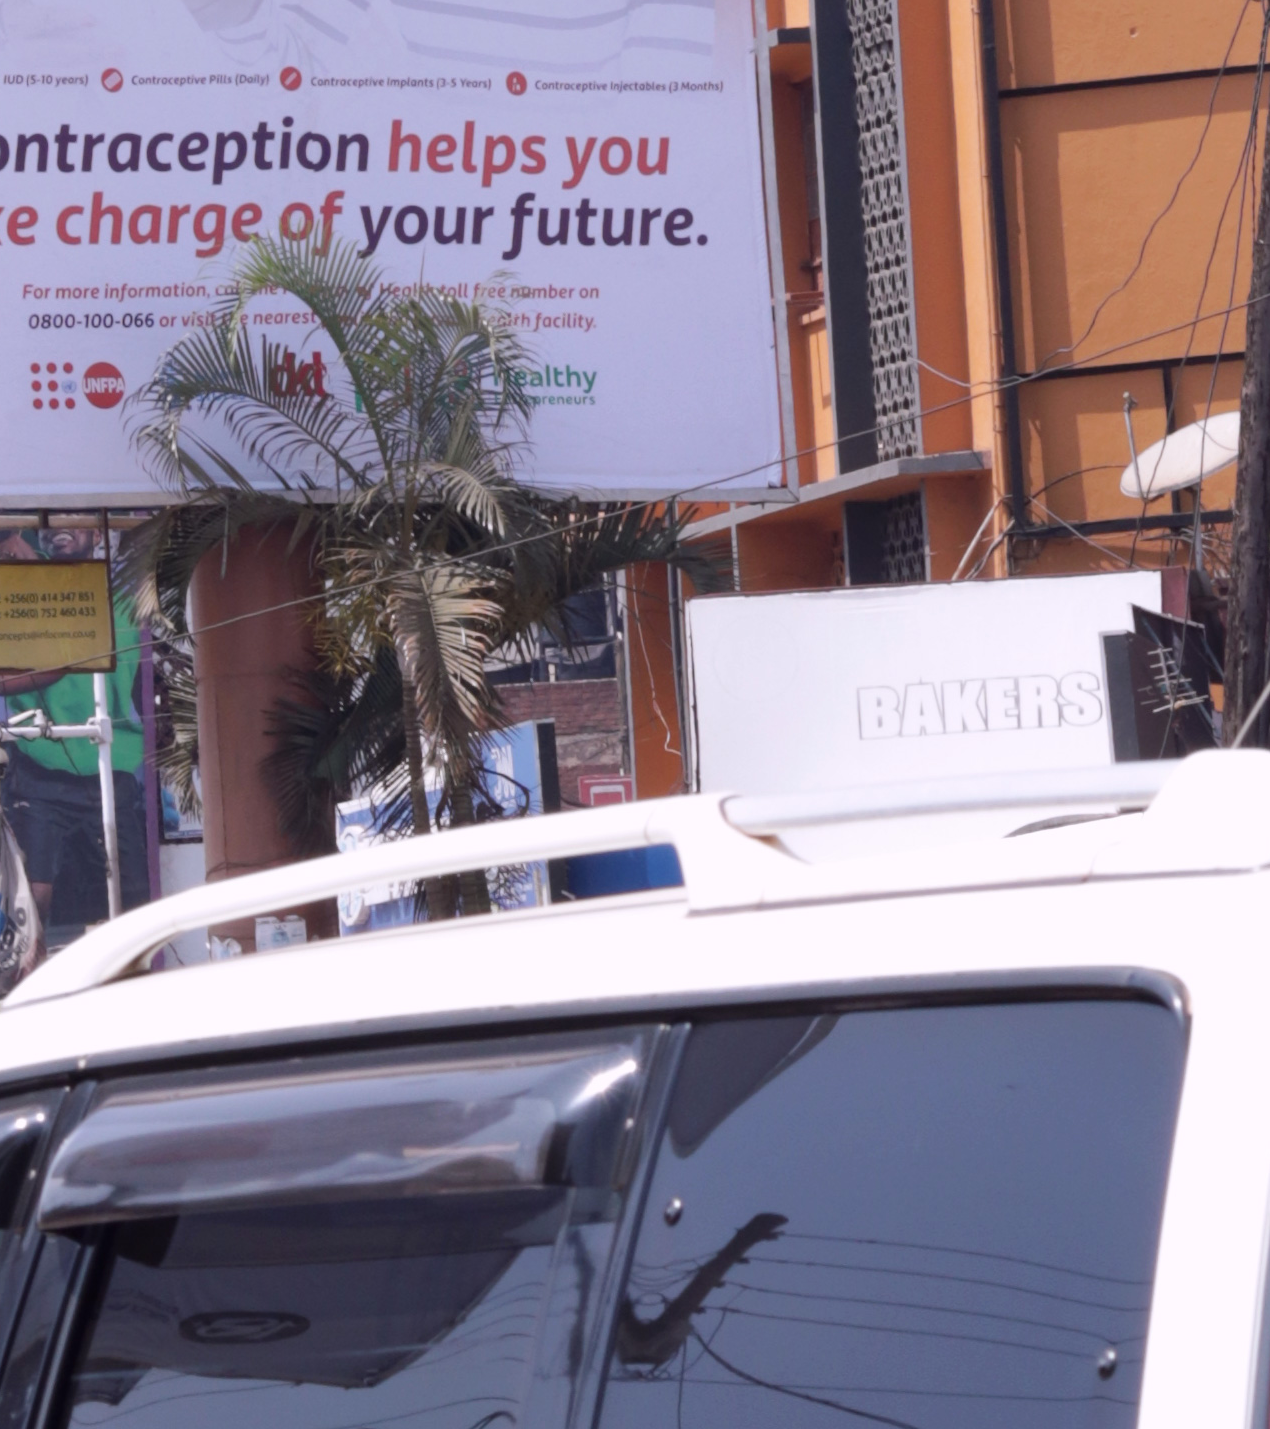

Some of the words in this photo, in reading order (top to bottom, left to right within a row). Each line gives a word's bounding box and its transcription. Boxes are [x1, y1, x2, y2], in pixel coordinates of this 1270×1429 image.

[3, 75, 24, 85] IUD
[26, 74, 53, 87] (5-10
[55, 74, 89, 87] years)
[131, 74, 207, 89] Contraceptive
[209, 74, 232, 86] Pills
[234, 74, 270, 88] (Daily)
[310, 76, 384, 89] Contraceptive
[386, 77, 434, 90] Implants
[436, 77, 457, 90] (3-5
[459, 77, 492, 90] Years)
[534, 80, 608, 93] Contraceptive
[610, 80, 667, 93] Injectables
[668, 80, 679, 93] (3
[680, 80, 725, 93] Months)
[387, 119, 547, 188] helps
[562, 136, 670, 190] you
[56, 192, 262, 258] charge
[280, 190, 345, 257] of
[357, 203, 494, 259] your
[502, 192, 709, 261] future.
[22, 284, 51, 300] For
[56, 286, 100, 299] more
[104, 282, 211, 302] information,
[439, 283, 468, 299] toll
[474, 283, 506, 299] free
[511, 284, 575, 299] number
[579, 286, 600, 298] on
[28, 313, 155, 329] 0800-100-066
[159, 315, 177, 328] or
[182, 312, 216, 328] visit
[253, 311, 317, 325] nearest
[533, 313, 597, 332] facility.
[82, 377, 126, 393] UNFPA
[4, 593, 38, 604] +256(0)
[40, 593, 58, 602] 414
[60, 592, 76, 601] 347
[4, 608, 38, 619] +256(0)
[41, 608, 57, 617] 752
[857, 671, 1103, 740] BAKERS
